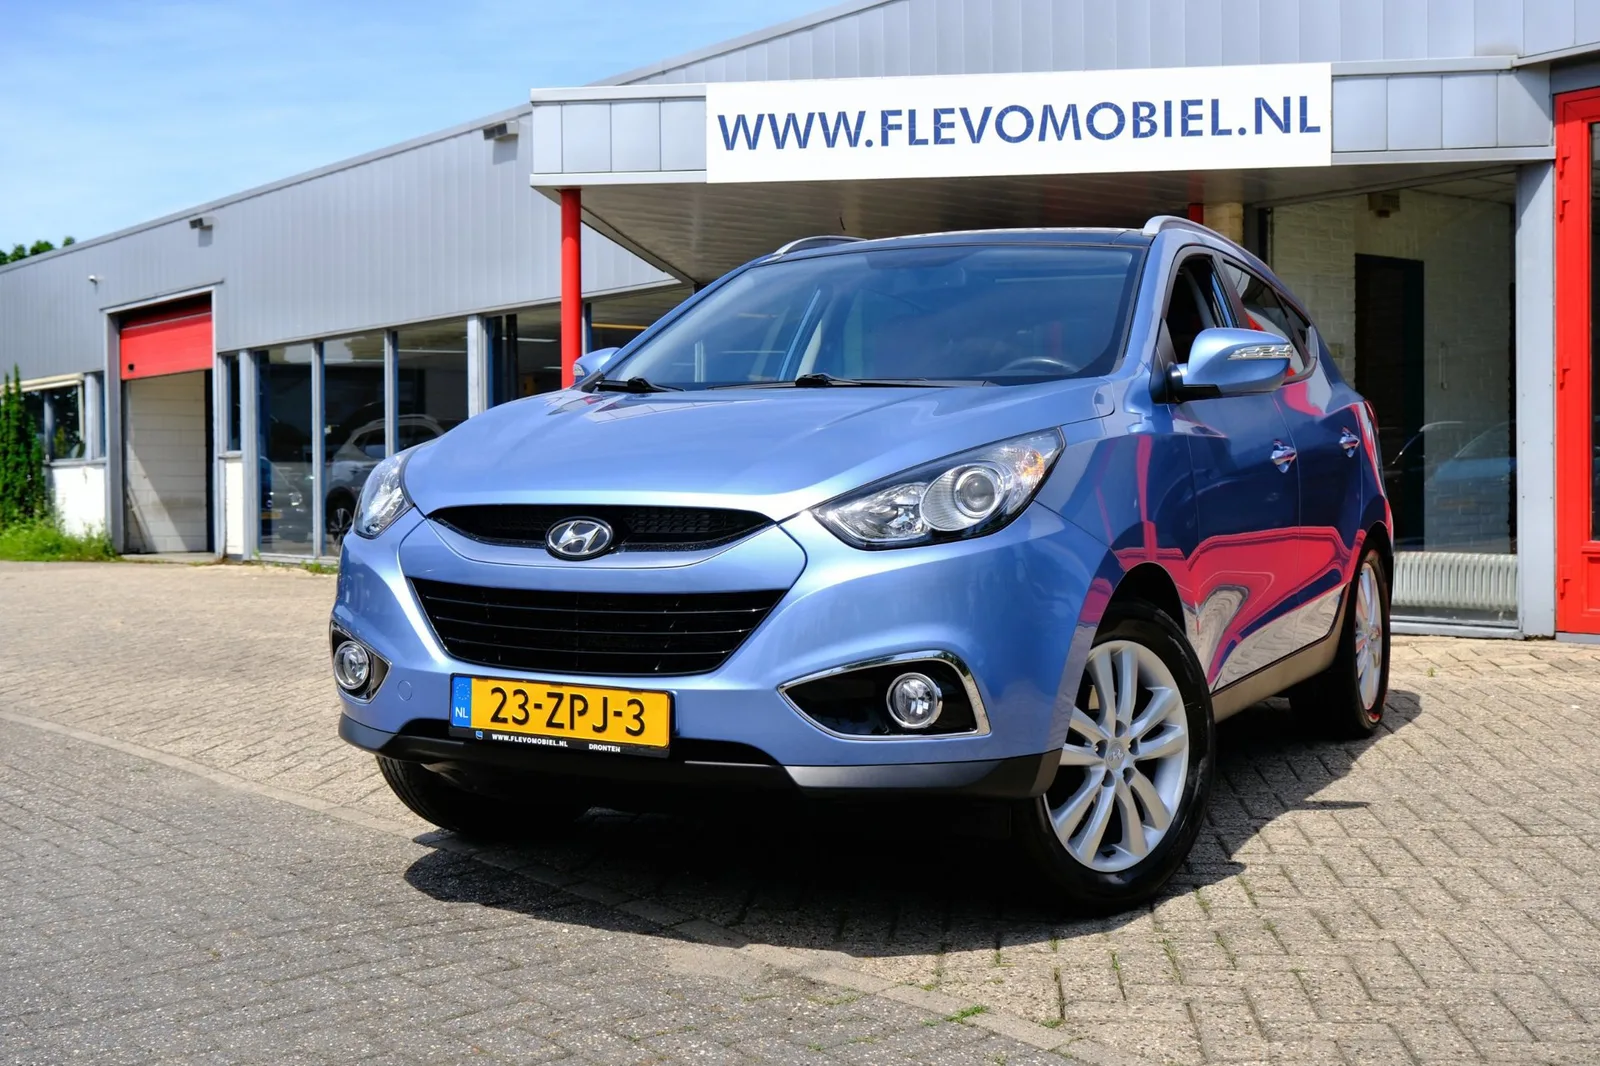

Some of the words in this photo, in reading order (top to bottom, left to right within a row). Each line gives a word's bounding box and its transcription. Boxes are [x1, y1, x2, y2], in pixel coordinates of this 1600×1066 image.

[717, 95, 1321, 151] WWW.FLEVOMOBIEL.NL
[455, 707, 469, 719] NL
[490, 687, 645, 736] 23-ZPJ-3
[492, 733, 569, 748] WWW.FLEVOMOBIEL.NL
[588, 743, 621, 753] DRONTEN
